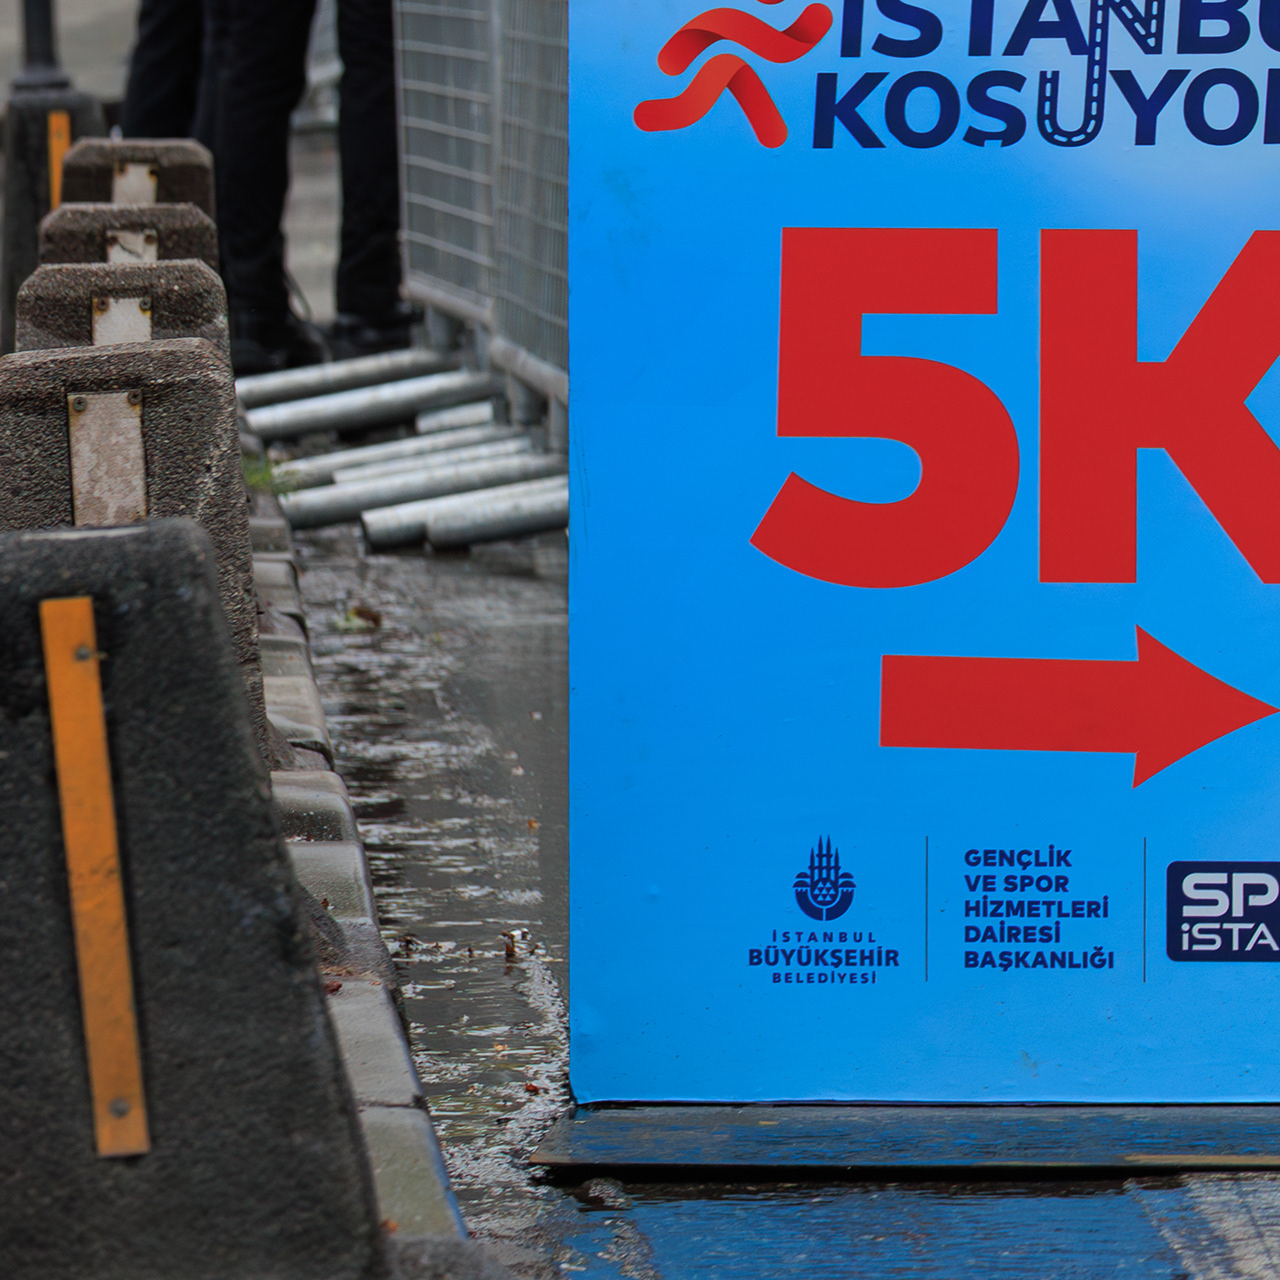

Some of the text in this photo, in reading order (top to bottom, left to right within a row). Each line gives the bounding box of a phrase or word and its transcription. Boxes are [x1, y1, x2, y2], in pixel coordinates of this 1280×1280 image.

[964, 844, 1073, 871] GENÇLİK
[964, 875, 1069, 893] VE SPOR
[964, 895, 1109, 918] HİZMETLERİ
[772, 929, 877, 943] İSTANBUL
[964, 921, 1061, 943] DAİRESİ
[748, 945, 900, 969] BÜYÜKŞEHİR
[964, 946, 1114, 972] BAŞKANLIĞI
[772, 971, 876, 984] BELEDİYESİ
